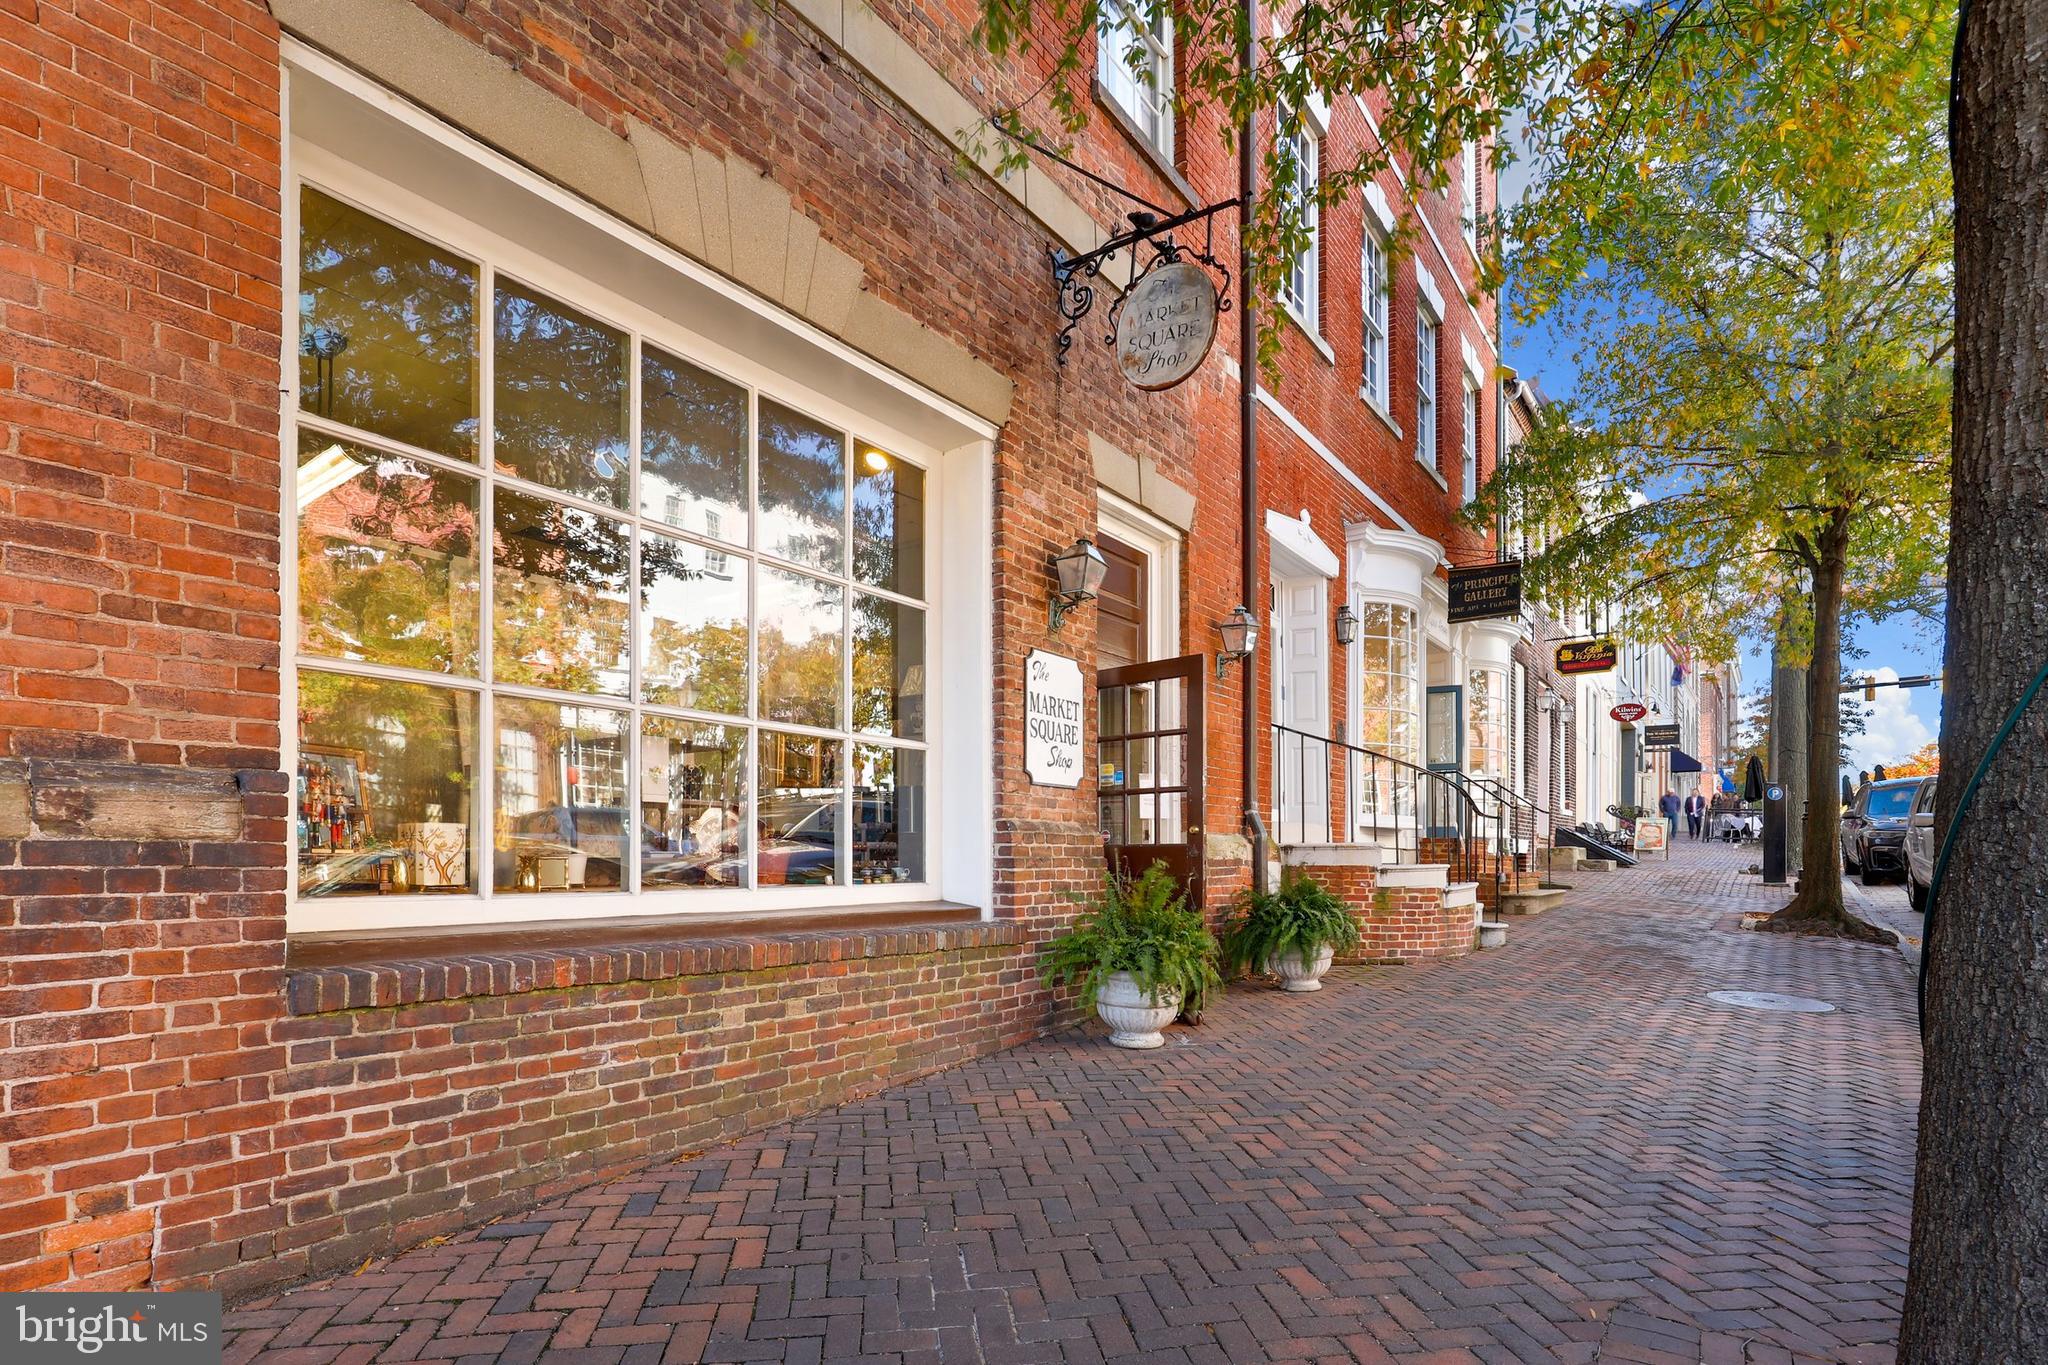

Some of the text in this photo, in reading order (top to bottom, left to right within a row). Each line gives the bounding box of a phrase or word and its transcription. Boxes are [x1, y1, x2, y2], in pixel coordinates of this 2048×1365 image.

[1128, 319, 1201, 353] SQUARE
[1138, 350, 1188, 374] Shop
[1464, 587, 1508, 602] GALLERY
[1032, 660, 1050, 682] The
[1029, 691, 1080, 721] MARKET
[1029, 717, 1079, 746] SQUARE
[1047, 745, 1073, 774] Shop
